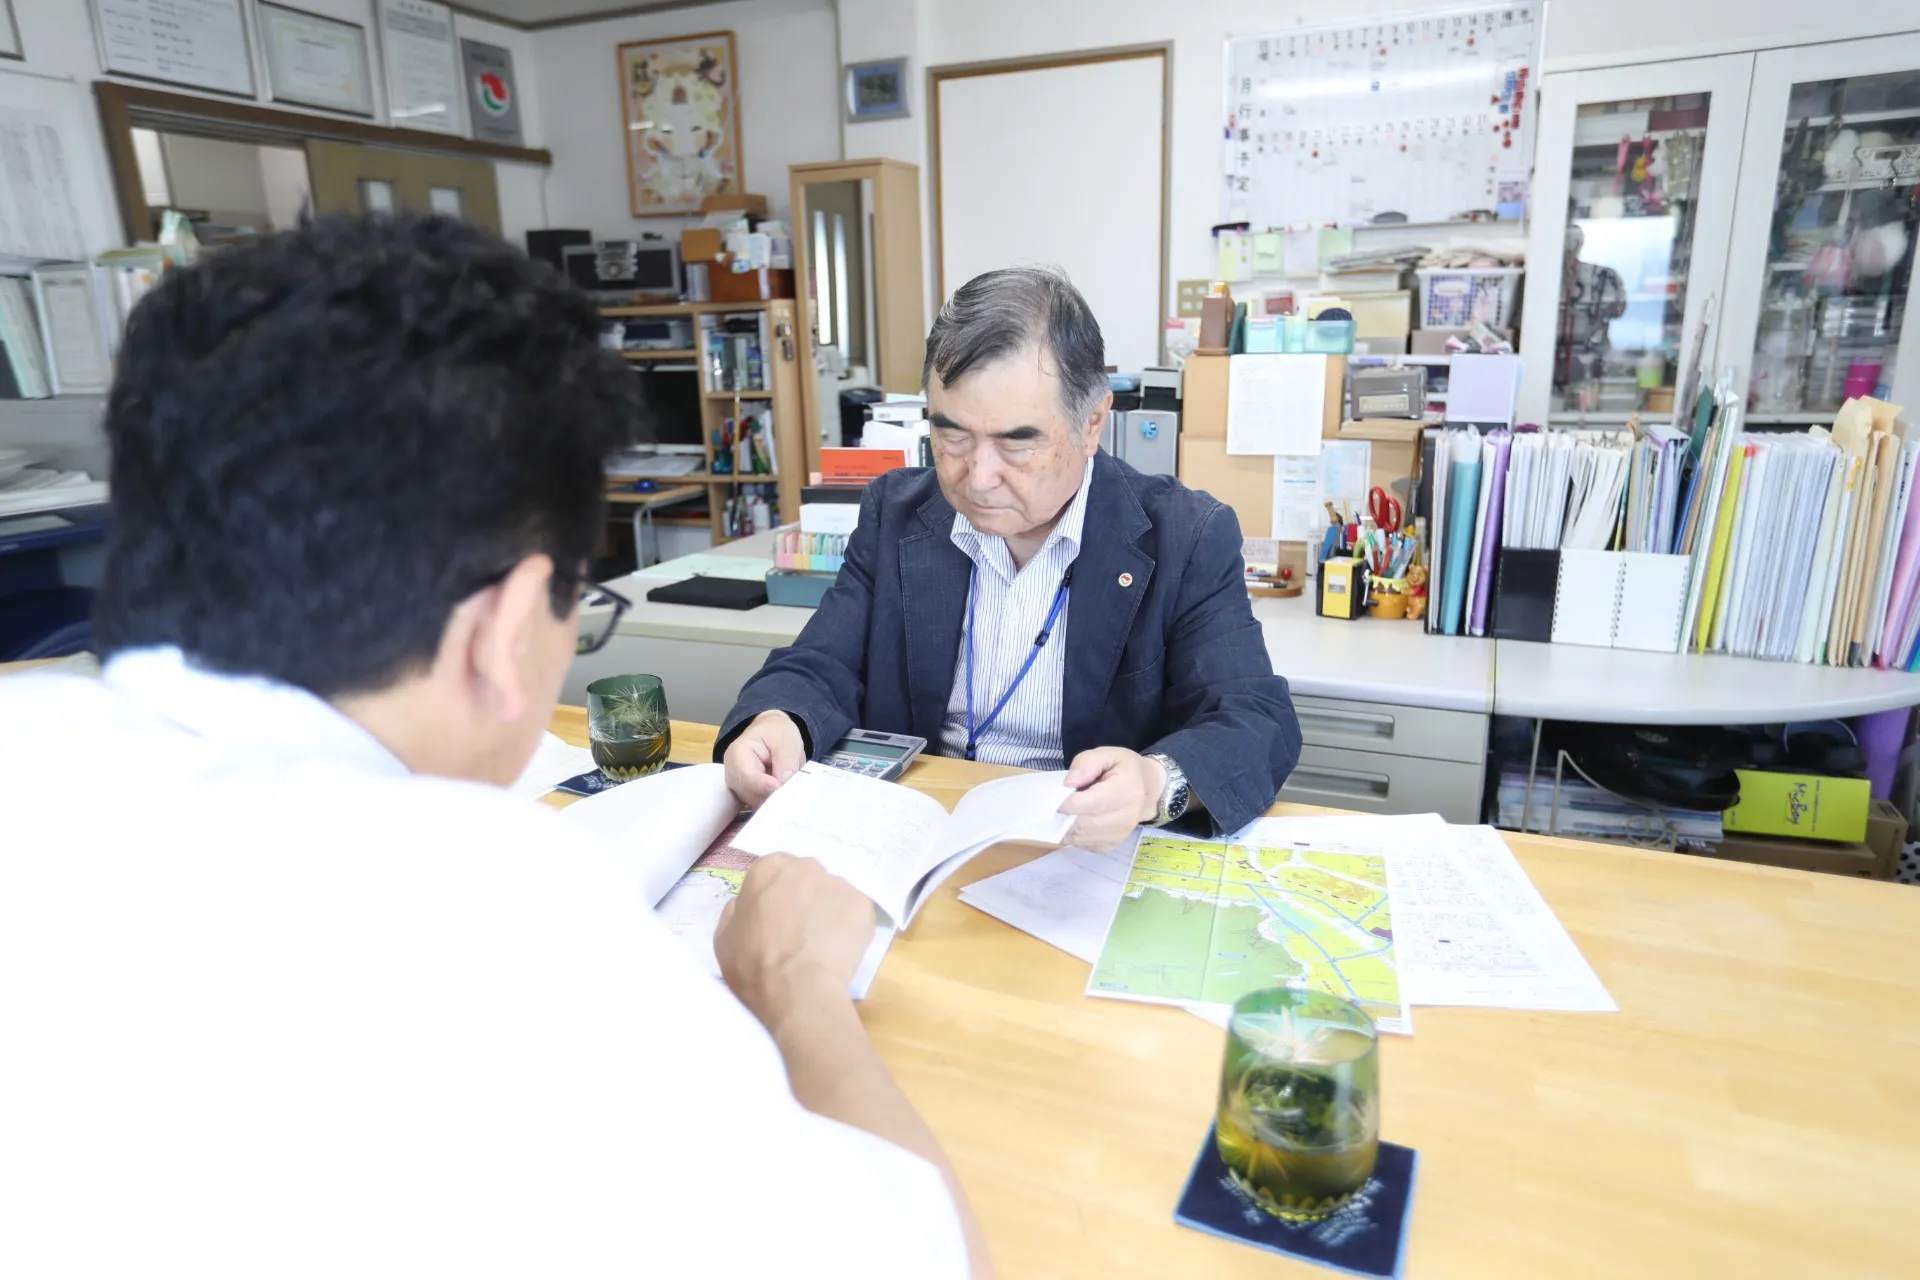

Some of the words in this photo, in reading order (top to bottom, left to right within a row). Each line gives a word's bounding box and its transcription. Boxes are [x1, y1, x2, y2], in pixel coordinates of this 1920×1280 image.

[1236, 77, 1252, 192] 月行事予定
